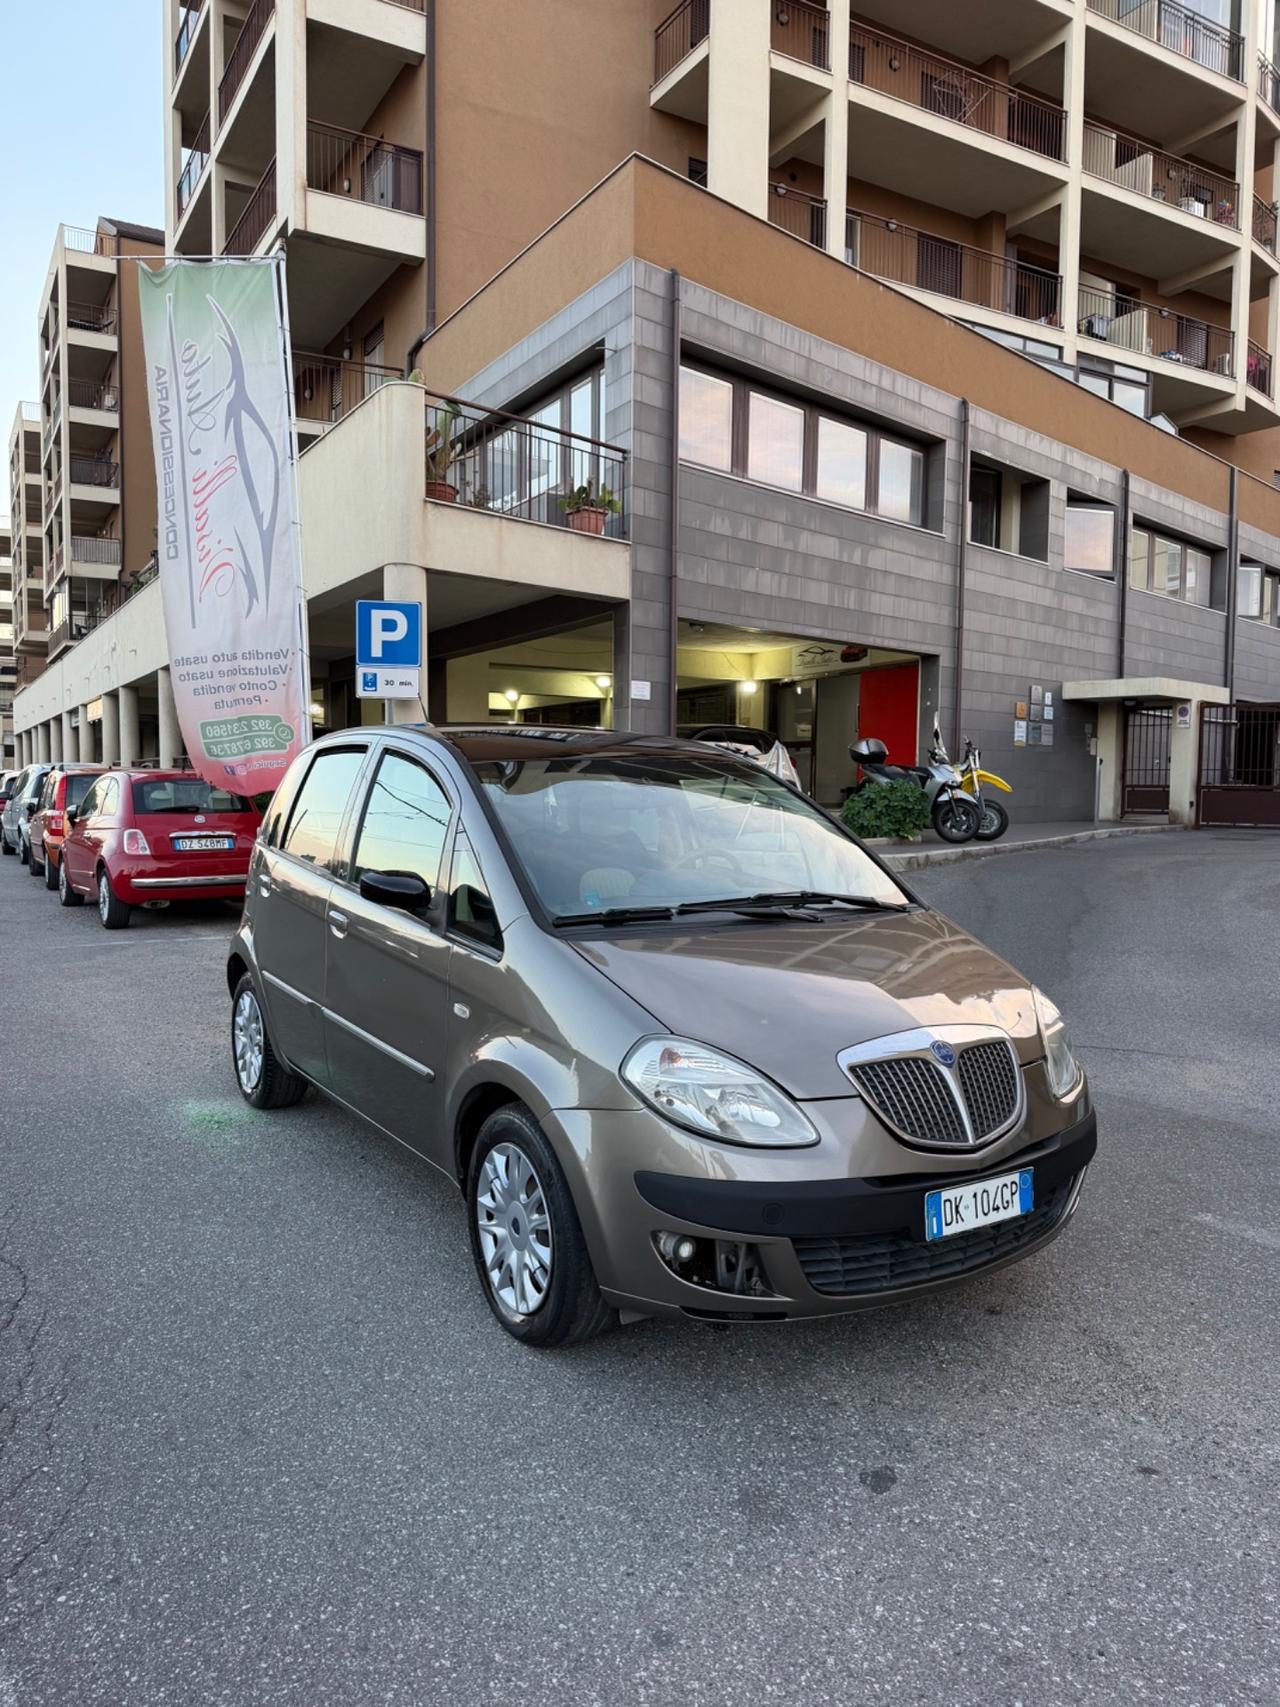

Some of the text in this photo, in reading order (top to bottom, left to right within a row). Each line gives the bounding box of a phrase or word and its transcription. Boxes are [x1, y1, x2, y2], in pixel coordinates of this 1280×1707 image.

[371, 609, 408, 658] P
[399, 679, 414, 687] min.
[181, 839, 227, 849] DZ 548MF
[943, 1195, 965, 1226] DK
[973, 1181, 1018, 1219] 104GP
